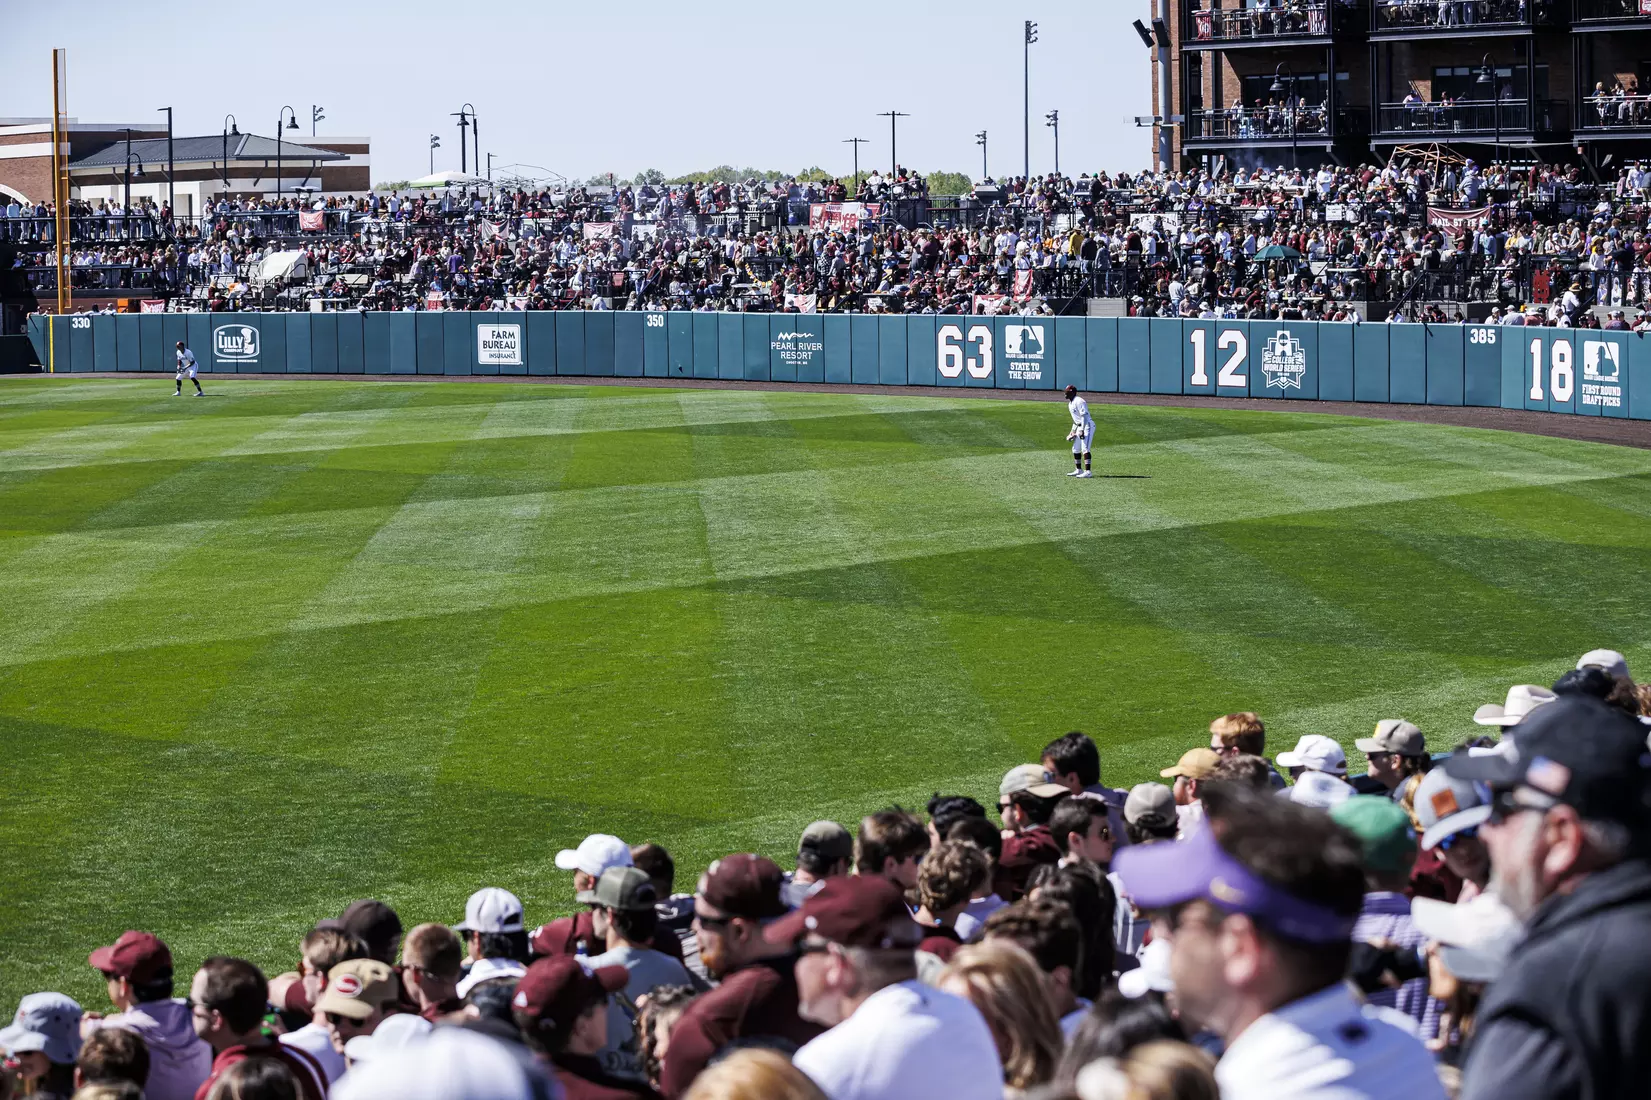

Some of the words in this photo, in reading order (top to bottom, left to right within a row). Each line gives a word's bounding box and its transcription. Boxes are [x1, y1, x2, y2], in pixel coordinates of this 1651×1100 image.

[1453, 217, 1478, 227] STTE
[72, 317, 90, 328] 330
[647, 314, 664, 327] 350
[491, 330, 516, 339] FARM
[1470, 328, 1496, 344] 385
[218, 335, 243, 349] LILLY
[482, 340, 517, 350] BUREAU
[770, 341, 797, 350] PEARL
[798, 342, 823, 351] RIVER
[780, 351, 813, 360] RESORT
[937, 324, 993, 379] 63
[1190, 329, 1247, 387] 12
[1010, 362, 1030, 371] STATE
[1030, 362, 1040, 372] TO
[1283, 364, 1304, 373] SERIES
[1529, 337, 1574, 402] 18
[1008, 370, 1022, 379] THE
[1022, 371, 1042, 380] SHOW
[1581, 384, 1600, 395] FIRST
[1600, 385, 1621, 397] ROUND
[1582, 394, 1602, 406] DRAFT
[1602, 396, 1621, 407] PICKS
